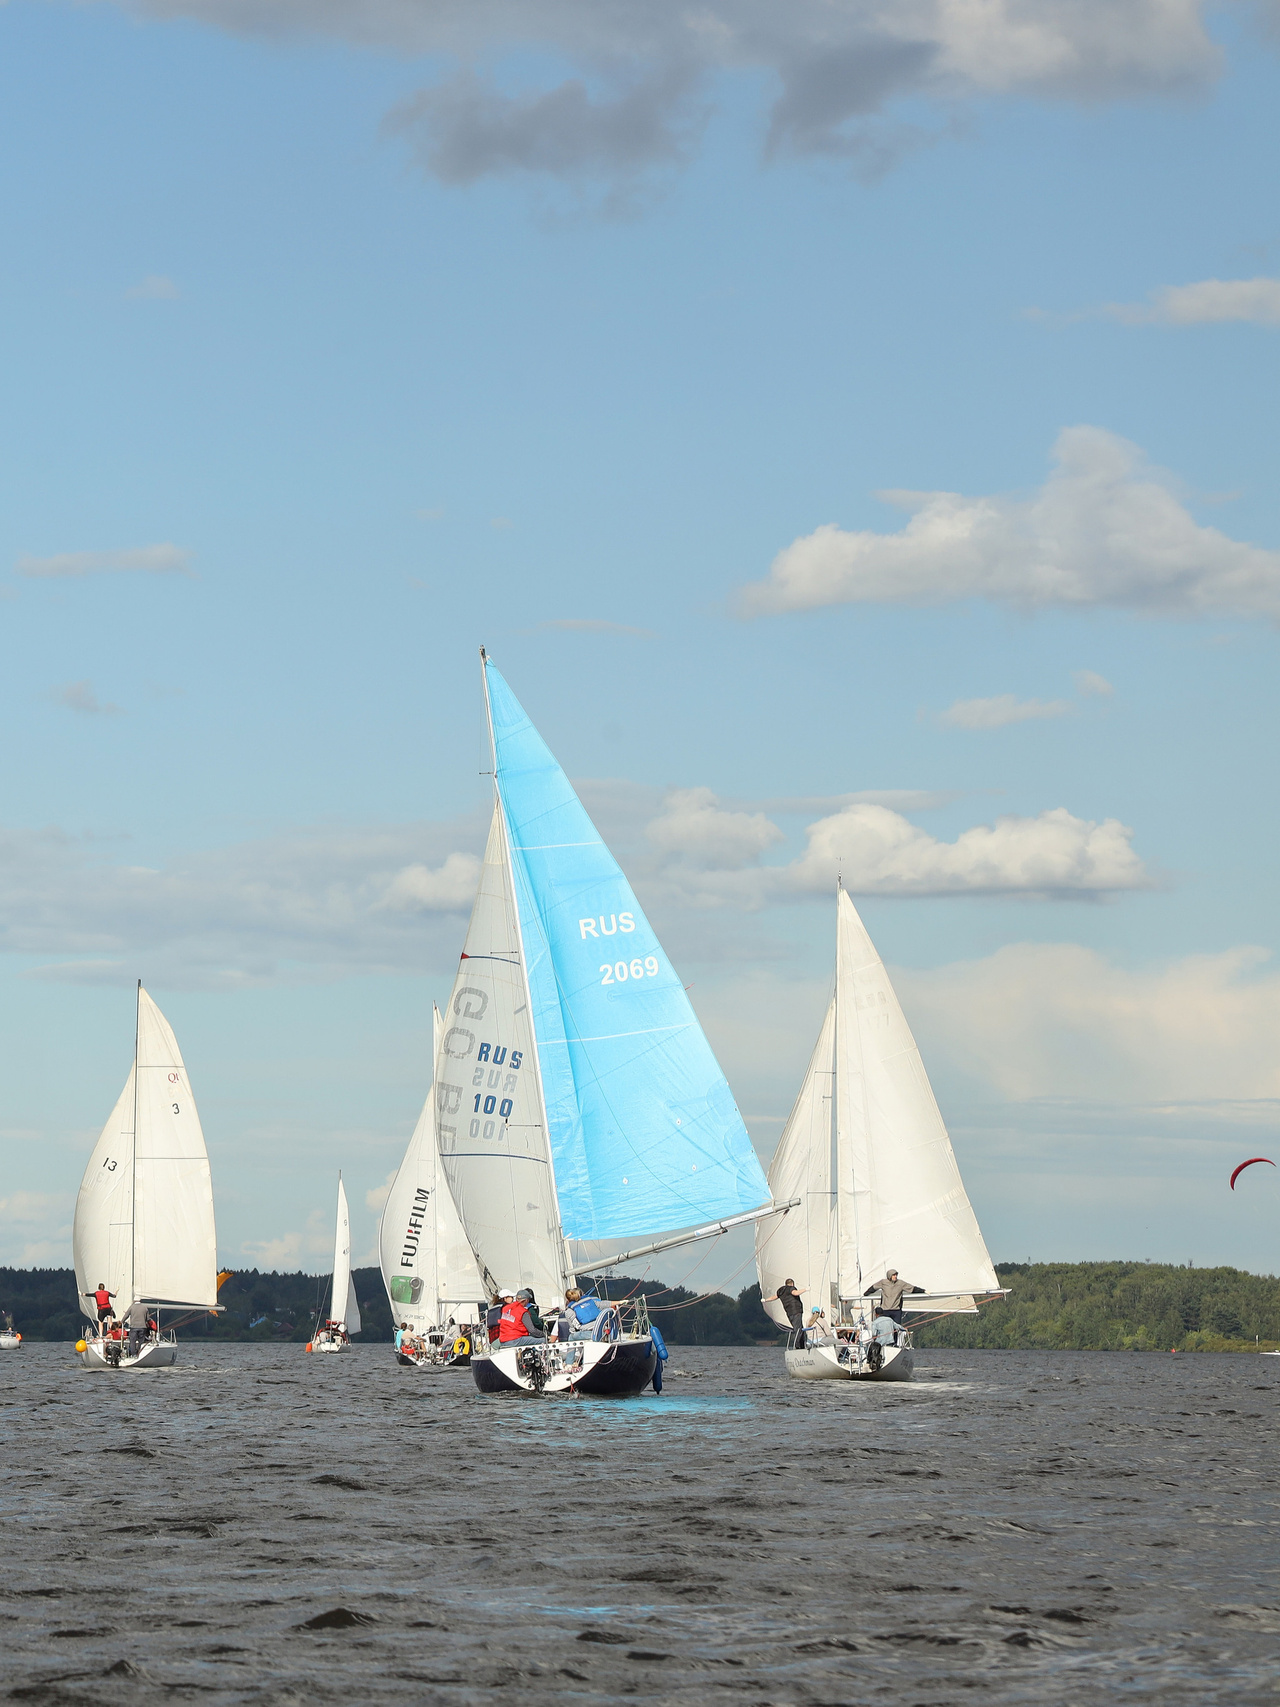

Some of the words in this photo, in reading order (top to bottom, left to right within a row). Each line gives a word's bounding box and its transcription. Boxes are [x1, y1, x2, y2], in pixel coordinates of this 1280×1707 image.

[578, 912, 636, 940] RUS
[599, 956, 659, 985] 2069
[477, 1042, 523, 1070] RUS
[172, 1103, 180, 1114] 3
[473, 1093, 514, 1118] 100
[103, 1157, 117, 1171] 13
[401, 1187, 430, 1267] FUJIFILM
